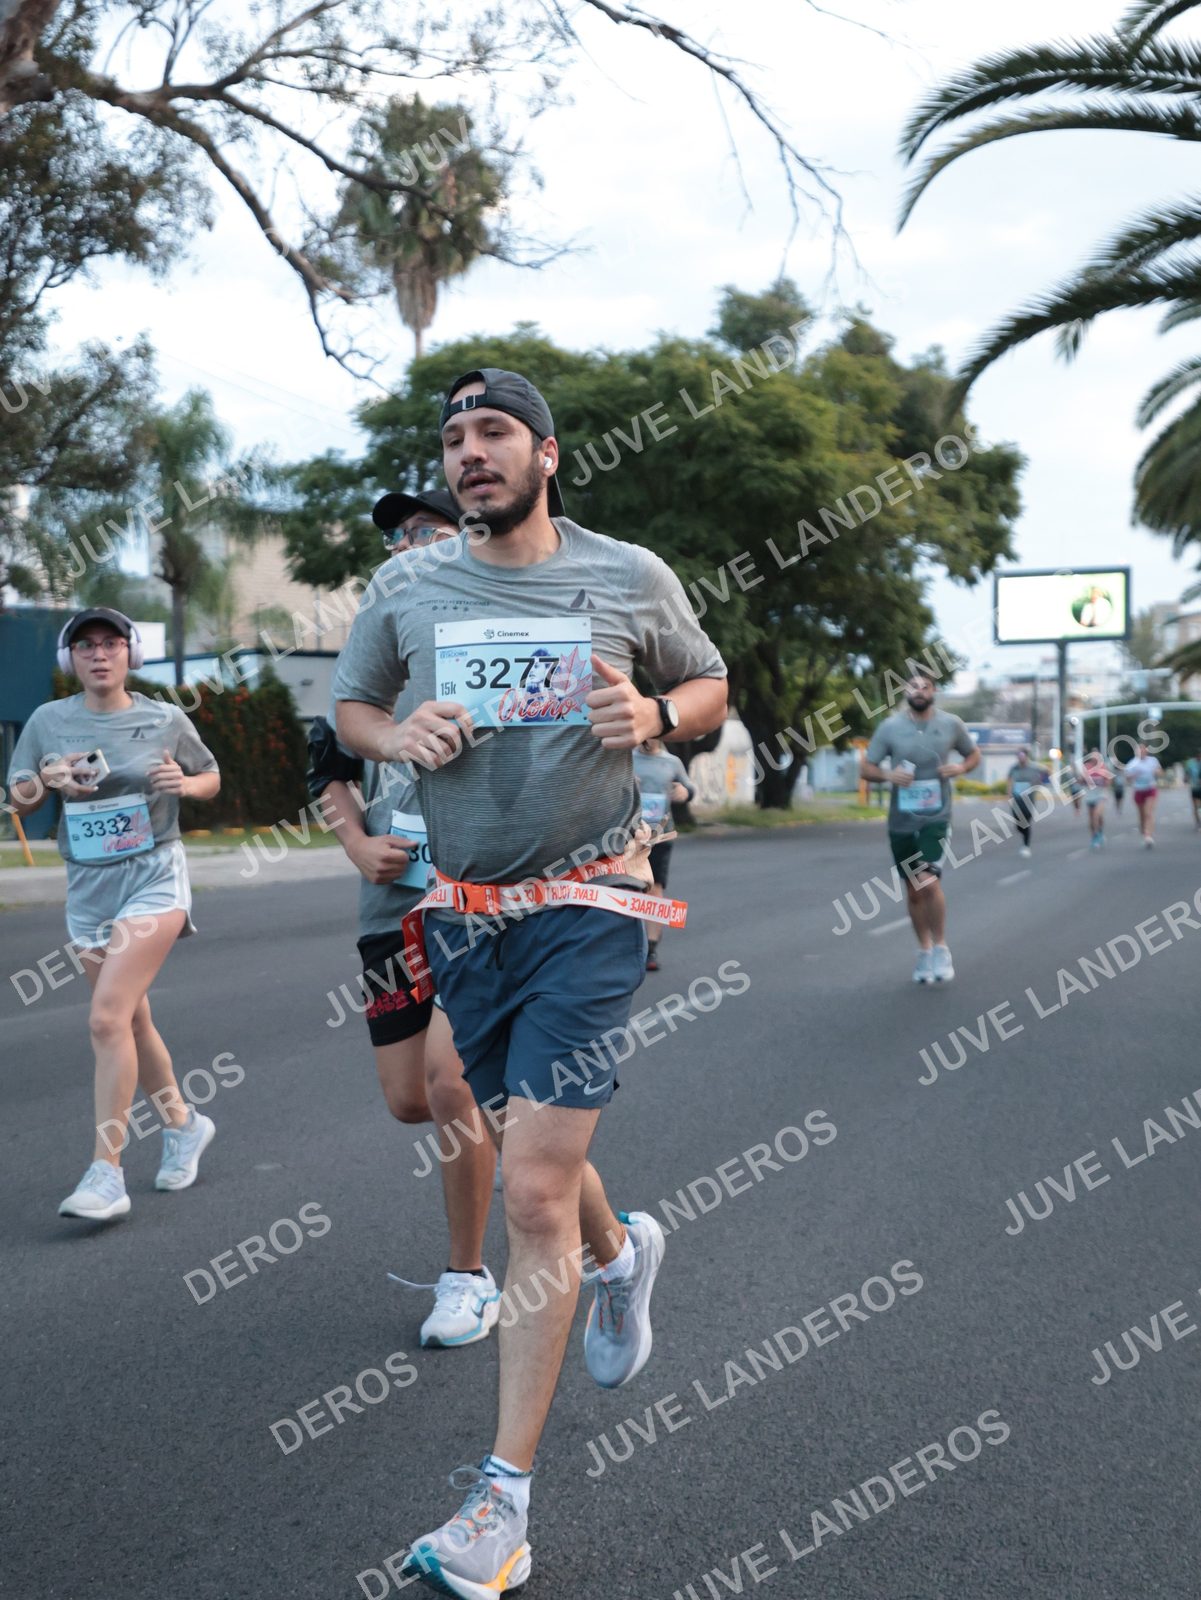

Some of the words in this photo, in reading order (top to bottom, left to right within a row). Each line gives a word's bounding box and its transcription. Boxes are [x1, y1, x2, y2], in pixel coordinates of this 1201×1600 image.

[497, 630, 529, 638] Cinemex
[465, 657, 560, 690] 3277
[441, 681, 457, 696] 15k
[81, 815, 134, 838] 3332
